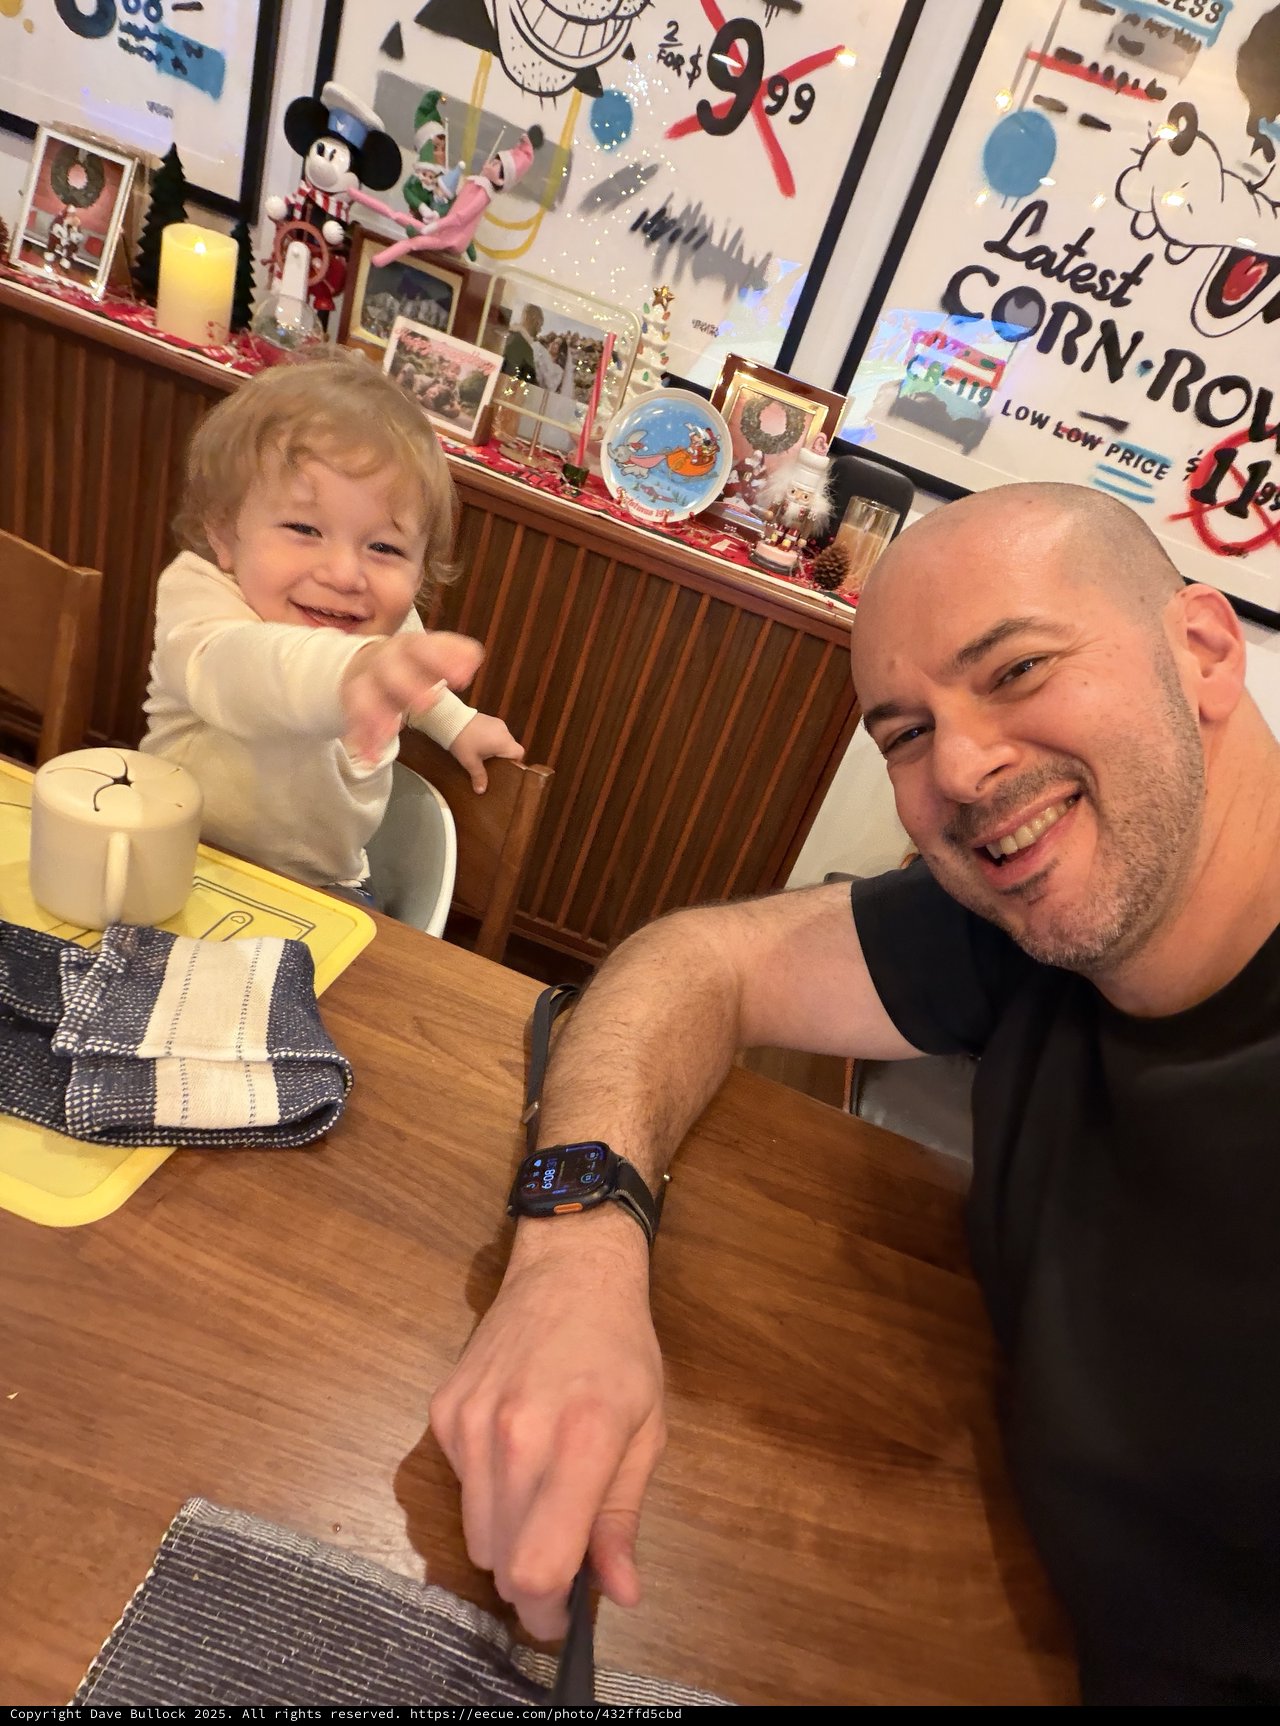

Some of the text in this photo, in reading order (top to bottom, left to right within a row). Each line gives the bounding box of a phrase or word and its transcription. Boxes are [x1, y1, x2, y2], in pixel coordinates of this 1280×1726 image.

[663, 20, 680, 42] 2
[656, 50, 685, 77] FOR
[984, 200, 1154, 308] Latest
[1001, 399, 1172, 480] LOW LOW PRICE
